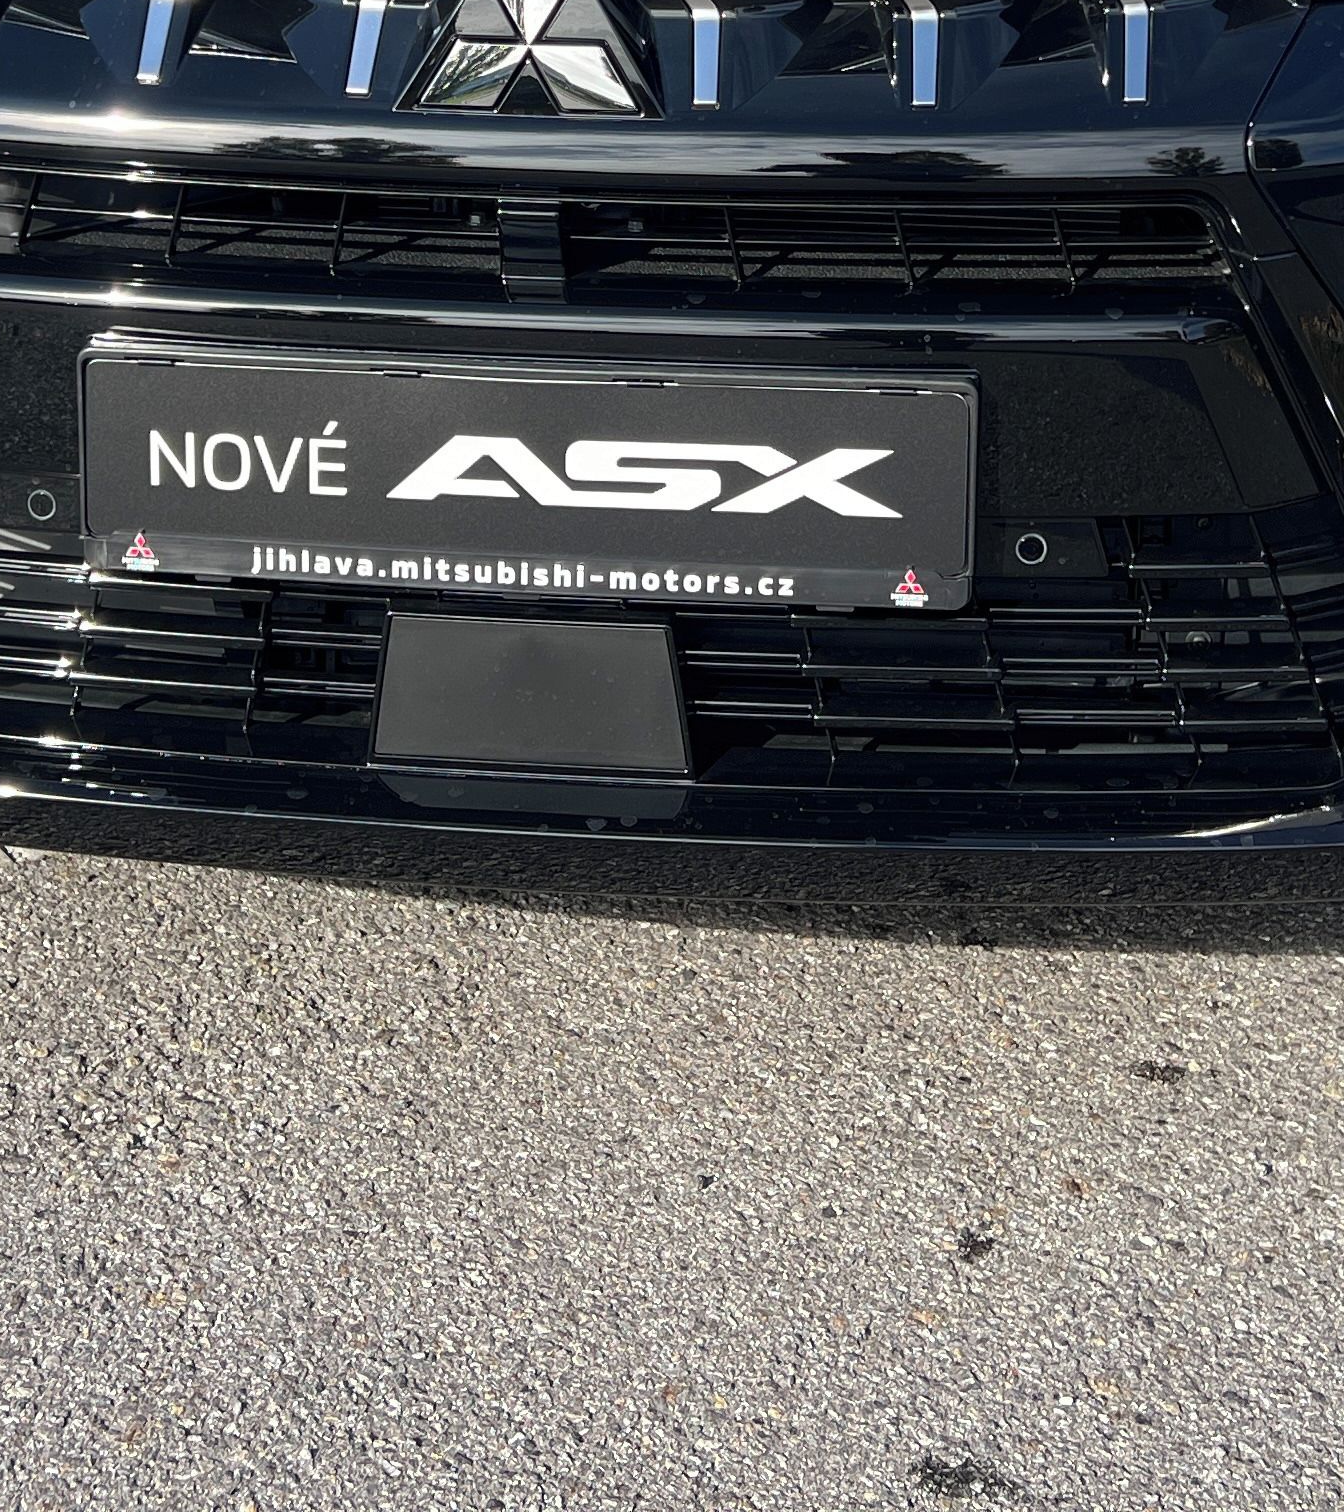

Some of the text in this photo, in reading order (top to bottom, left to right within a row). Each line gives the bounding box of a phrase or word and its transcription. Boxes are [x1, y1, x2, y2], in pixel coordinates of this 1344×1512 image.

[149, 420, 903, 519] NOVÉ ASX
[250, 545, 795, 598] jihlava.mitsubishi-motors.cz
